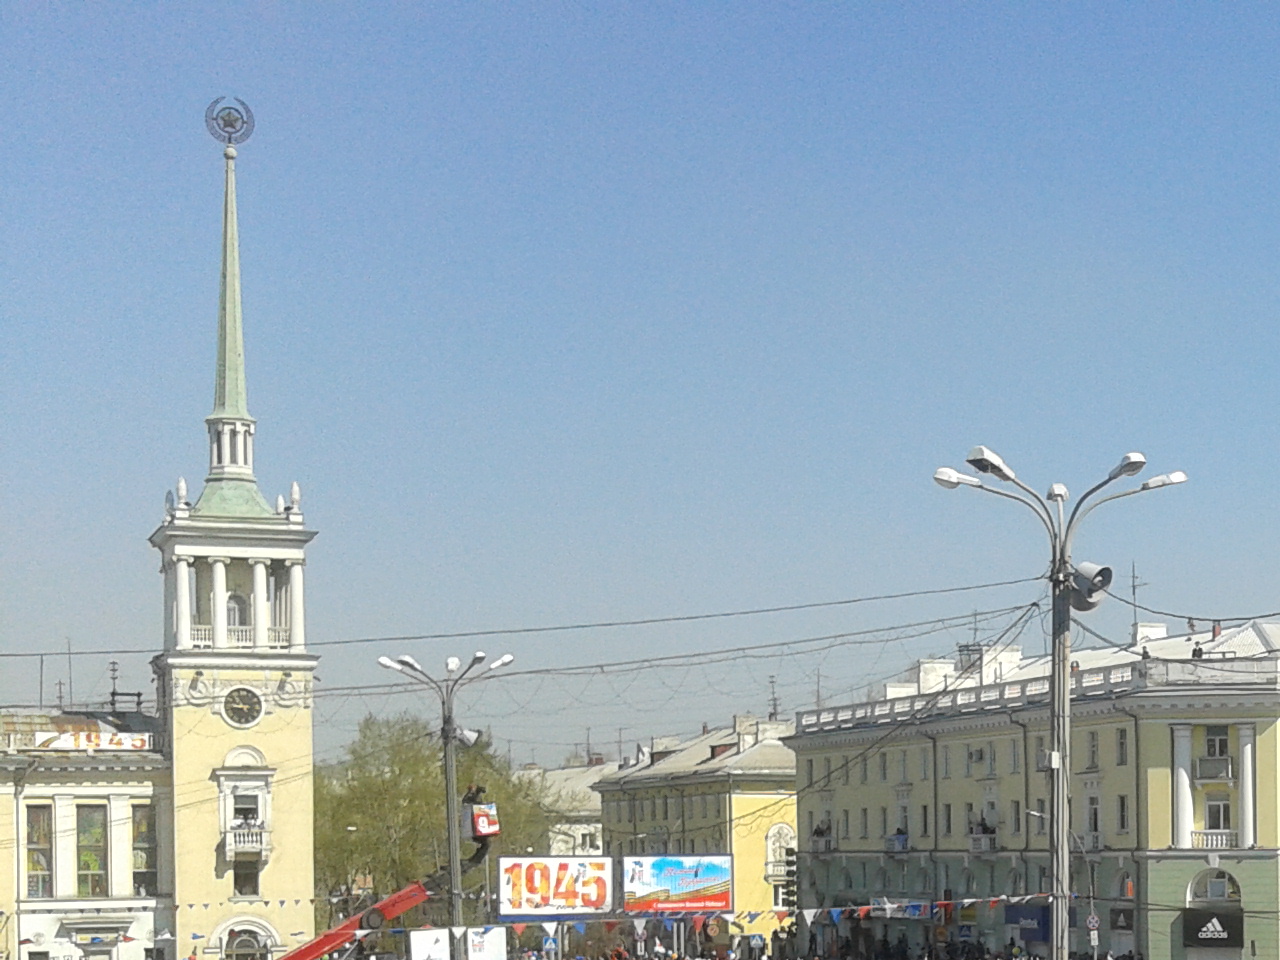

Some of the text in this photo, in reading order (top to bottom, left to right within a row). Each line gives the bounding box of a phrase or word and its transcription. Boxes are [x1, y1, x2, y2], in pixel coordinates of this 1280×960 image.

[69, 731, 147, 749] 1945
[504, 861, 607, 910] 1945
[1198, 930, 1228, 939] adidas
